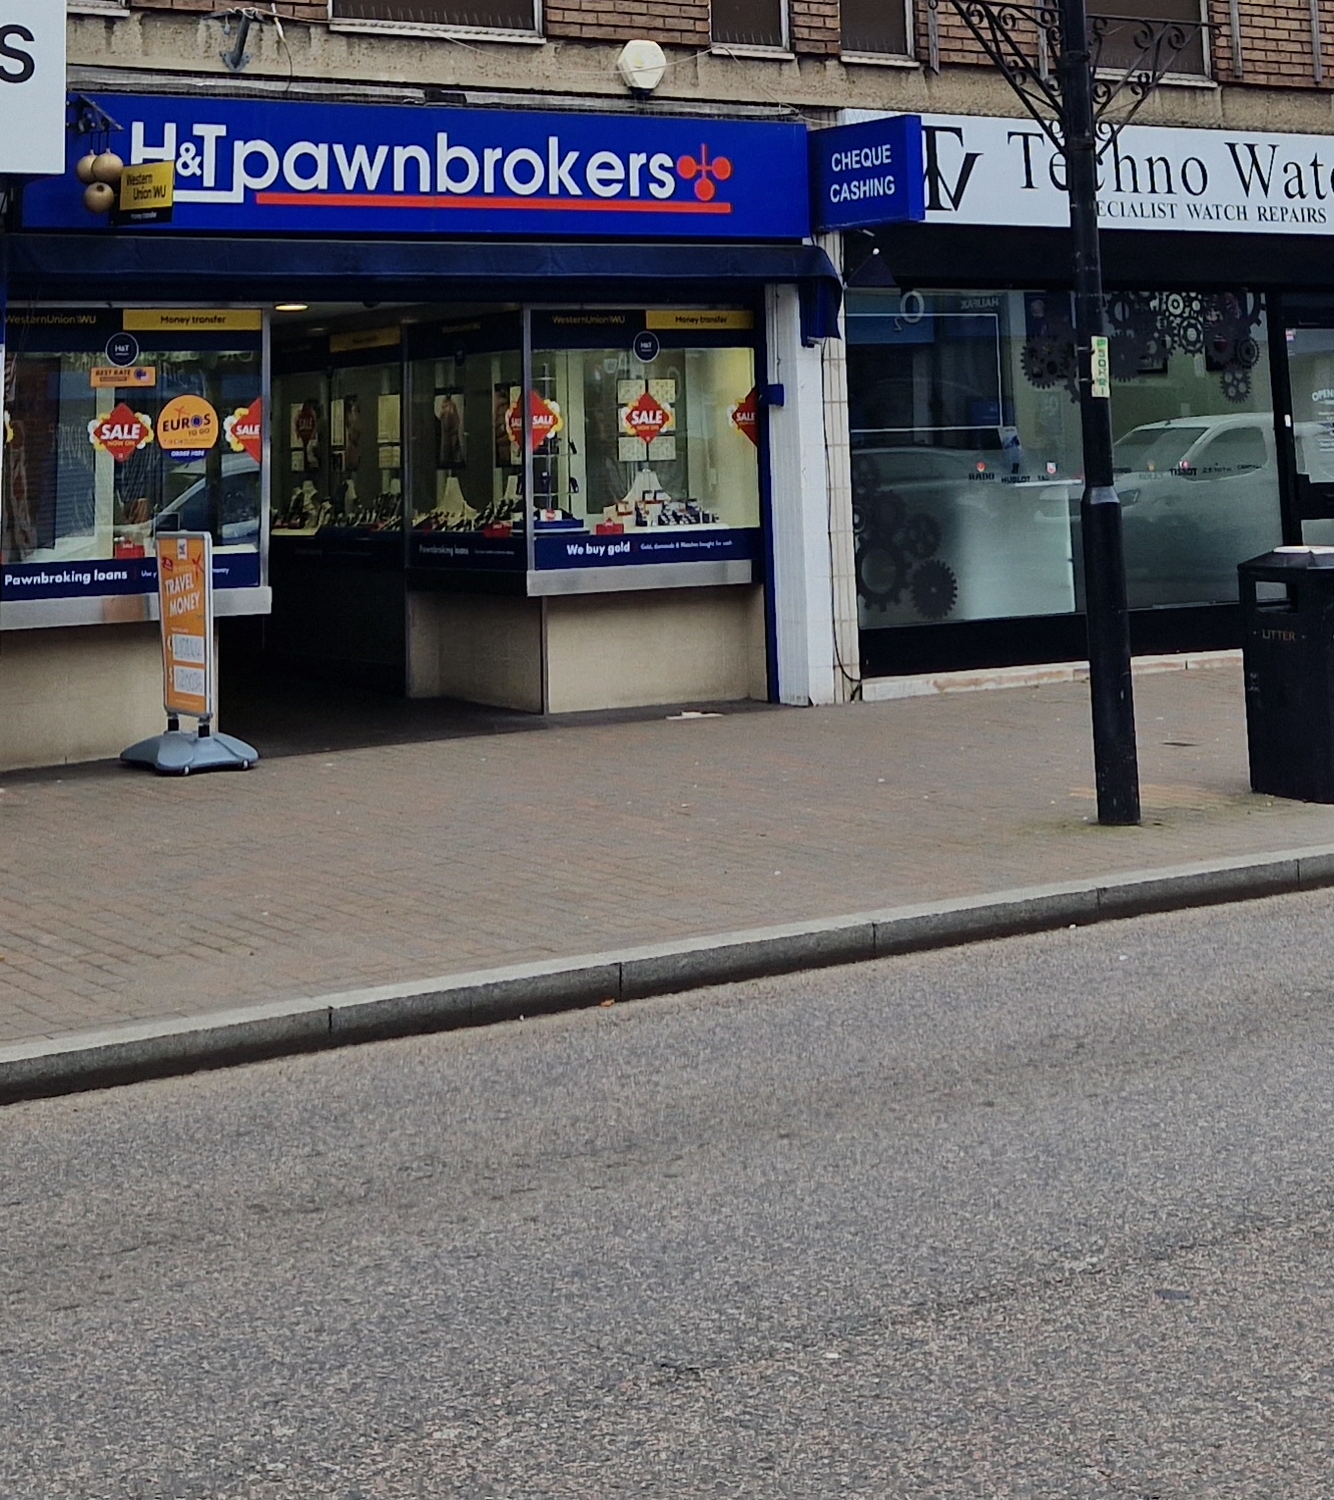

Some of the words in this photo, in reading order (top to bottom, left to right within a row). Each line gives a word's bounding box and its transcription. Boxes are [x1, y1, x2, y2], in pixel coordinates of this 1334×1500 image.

[830, 144, 893, 173] CHEQUE
[233, 131, 676, 203] pawnbrokers
[127, 173, 153, 187] Western
[133, 185, 152, 201] Union
[153, 184, 167, 199] WU
[829, 175, 896, 205] CASHING
[1097, 199, 1178, 221] ECIALIST
[1185, 202, 1249, 223] WATCH
[1256, 205, 1329, 226] REPAIRS
[160, 316, 191, 327] Money
[191, 315, 227, 324] transfer
[675, 315, 699, 325] Money
[699, 315, 728, 324] transfer
[114, 368, 131, 376] RATE
[162, 413, 211, 433] EUROS
[532, 414, 554, 426] SALE
[630, 411, 663, 426] SALE
[736, 412, 756, 422] SALE
[100, 423, 141, 440] SALE
[199, 428, 210, 436] GO
[235, 424, 260, 435] SALE
[1000, 475, 1031, 484] HUBLOT
[1169, 467, 1198, 477] TISSOT
[566, 544, 585, 556] We
[585, 542, 606, 557] buy
[607, 541, 631, 556] gold
[4, 570, 92, 586] Pawnbroking
[93, 568, 128, 582] loans
[164, 571, 195, 596] TRAVEL
[169, 590, 201, 618] MONEY
[1261, 628, 1296, 642] LITTER
